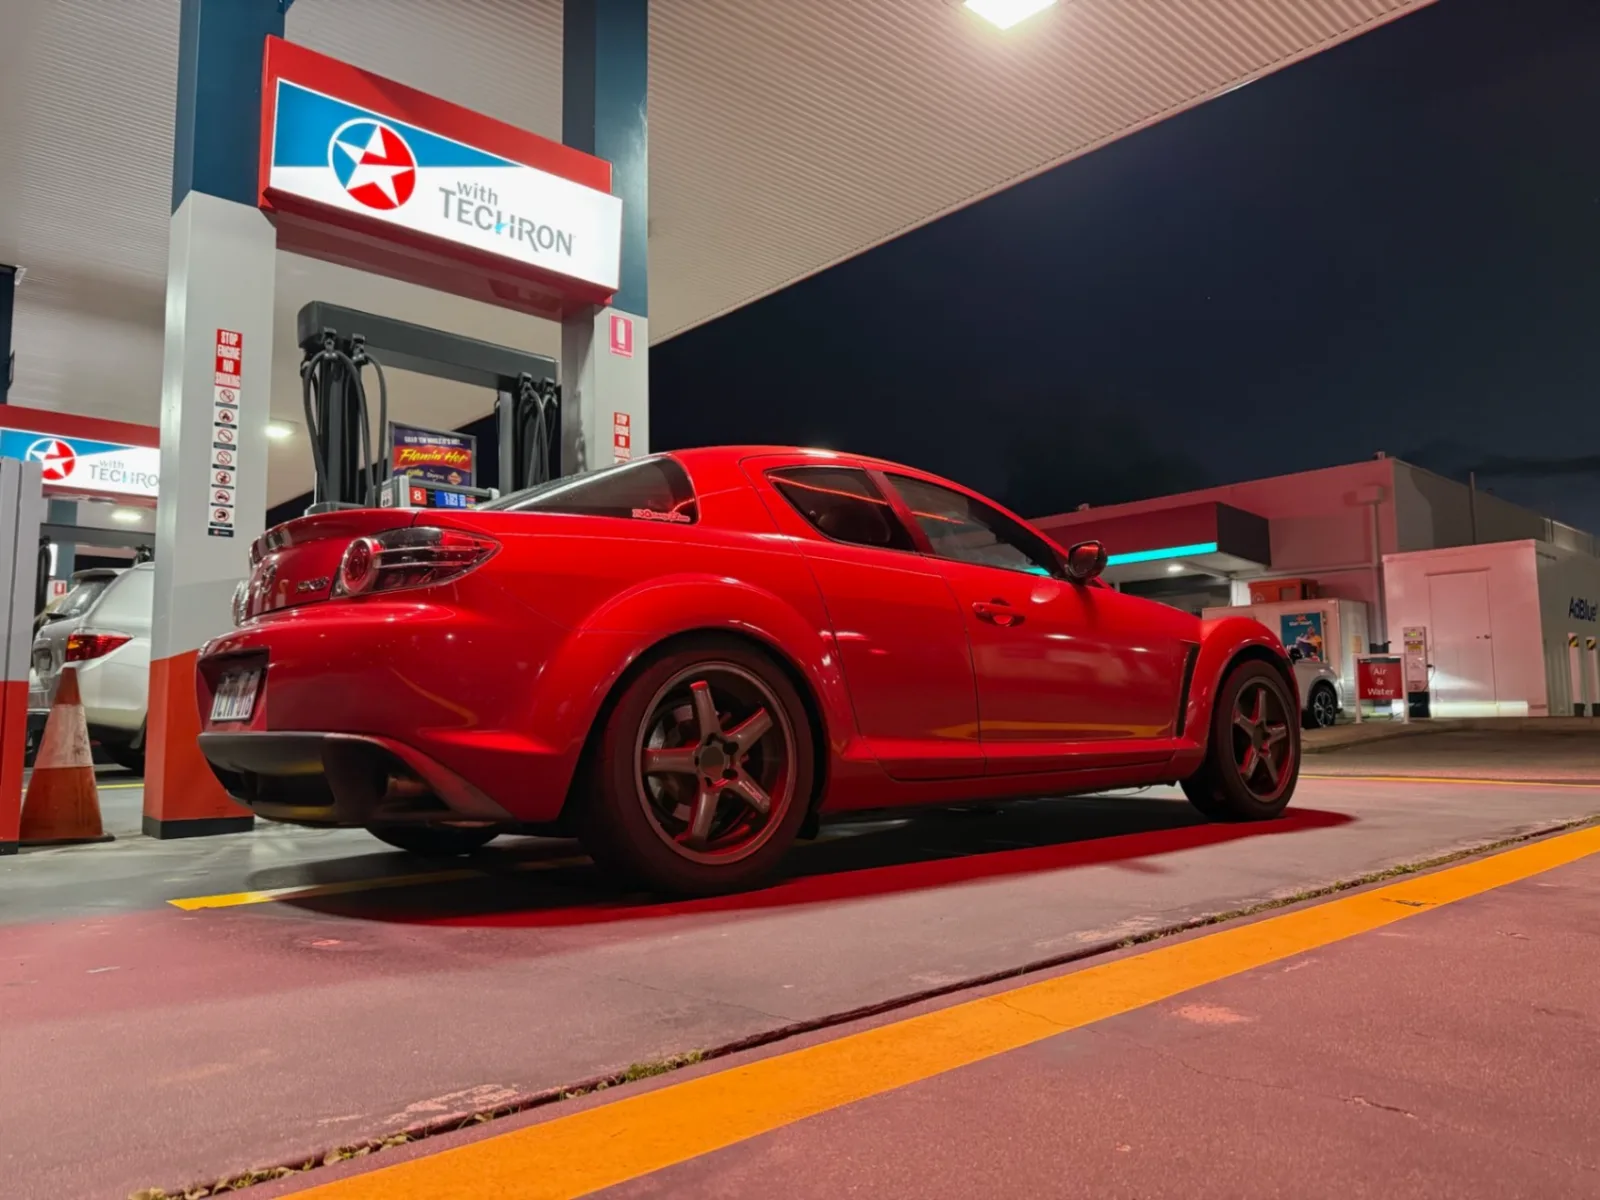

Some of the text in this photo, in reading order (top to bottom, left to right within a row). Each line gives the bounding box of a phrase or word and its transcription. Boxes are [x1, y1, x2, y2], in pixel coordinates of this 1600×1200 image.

[457, 181, 498, 206] with
[438, 186, 573, 257] TECHRON
[221, 331, 238, 346] STOP
[223, 359, 234, 373] NO
[99, 459, 125, 470] with
[88, 463, 160, 490] TECHRO
[414, 490, 422, 501] 8
[1568, 596, 1597, 622] AdBlue
[1373, 667, 1387, 676] Air
[1376, 677, 1384, 686] &
[1367, 688, 1394, 696] Water
